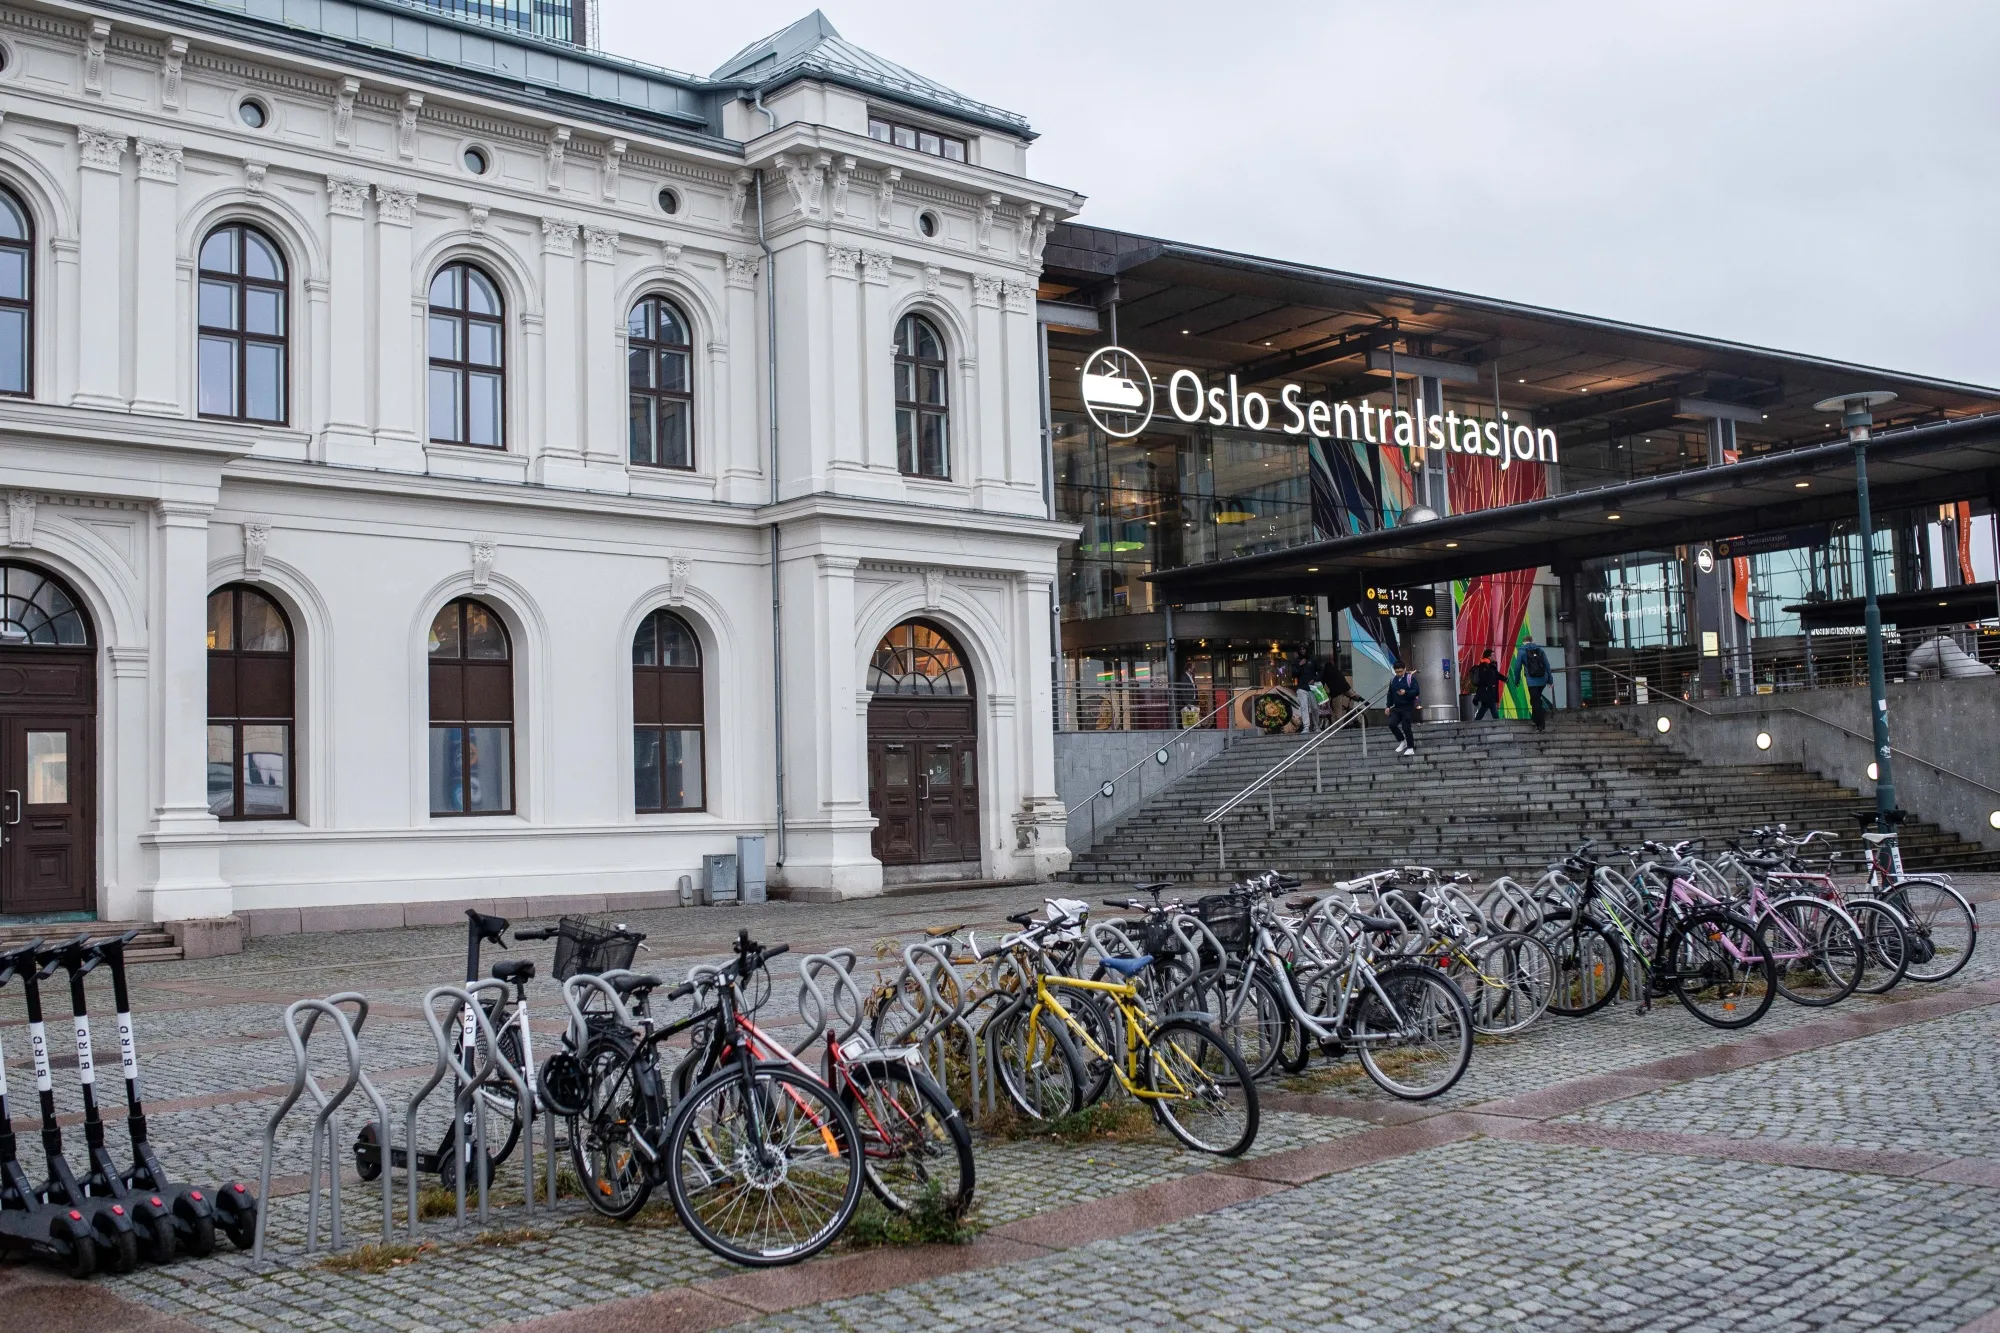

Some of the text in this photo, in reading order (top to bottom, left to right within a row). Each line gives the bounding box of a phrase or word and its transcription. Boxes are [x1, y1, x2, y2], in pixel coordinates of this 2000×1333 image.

[1169, 368, 1559, 470] Oslo Sentralstasjon
[1390, 590, 1408, 600] 1-12
[1391, 605, 1414, 616] 13-19
[33, 1036, 46, 1078] BIRD
[77, 1028, 90, 1071] BIRD
[120, 1025, 133, 1067] BIRD
